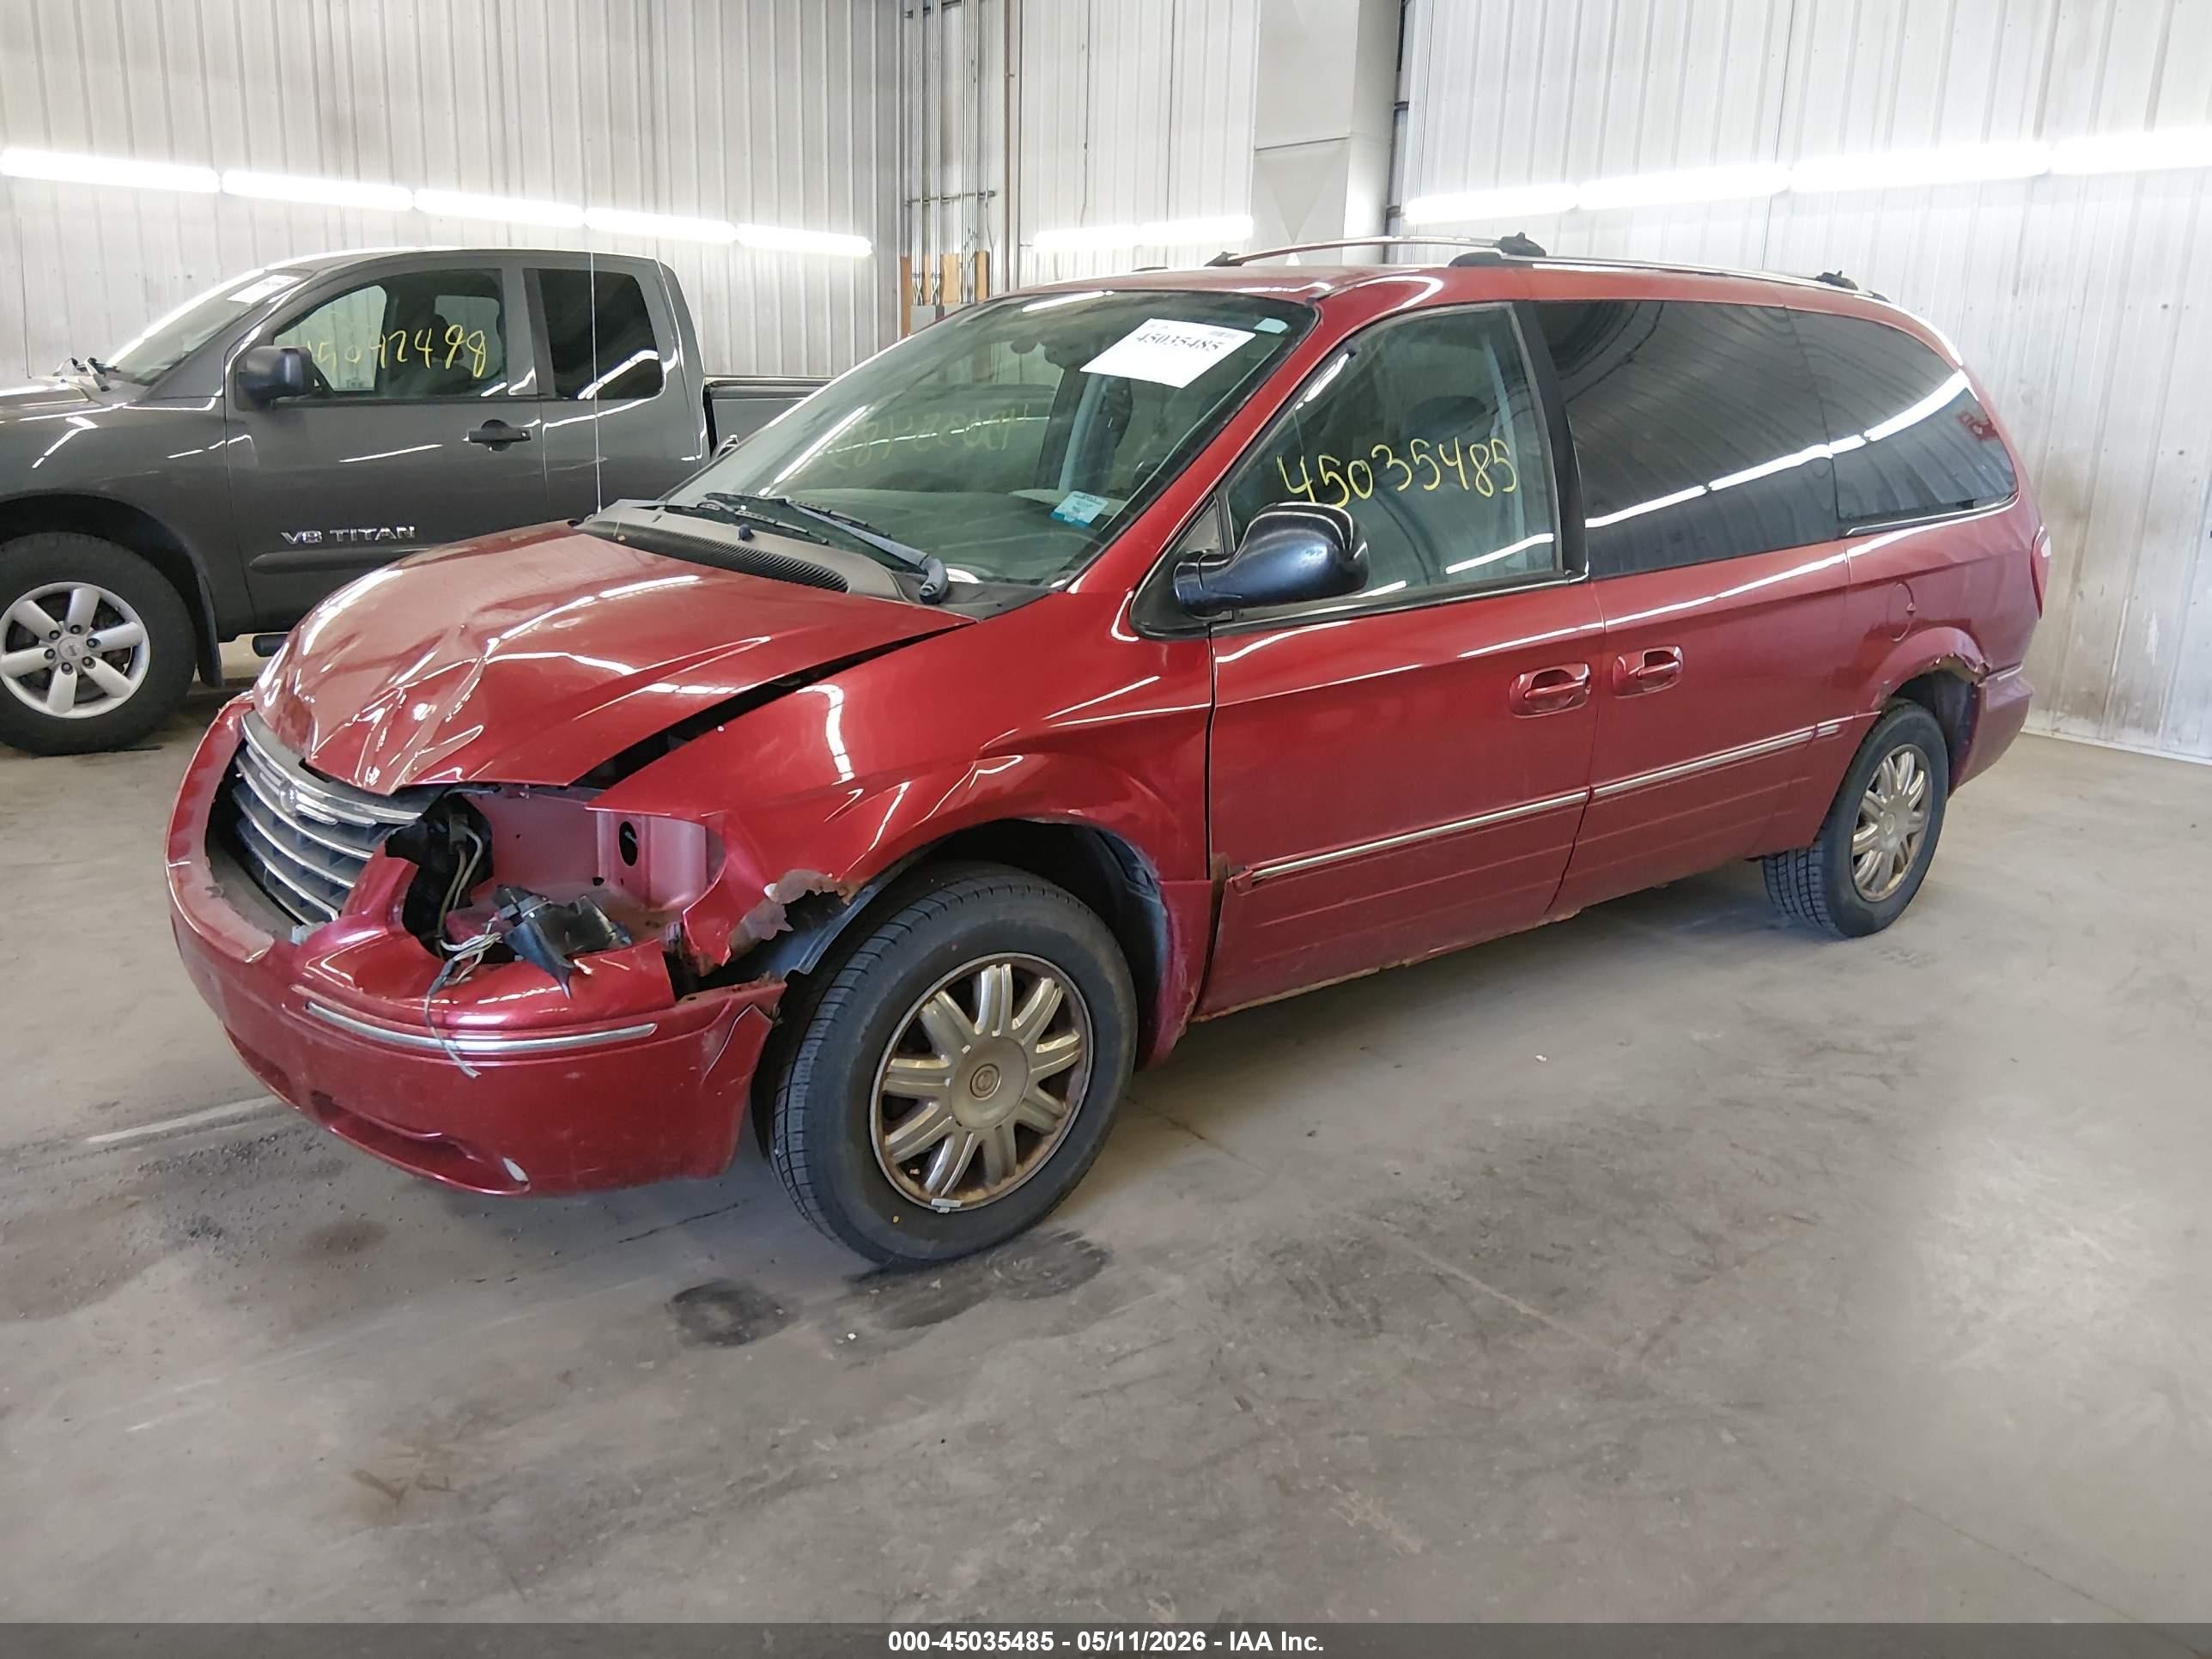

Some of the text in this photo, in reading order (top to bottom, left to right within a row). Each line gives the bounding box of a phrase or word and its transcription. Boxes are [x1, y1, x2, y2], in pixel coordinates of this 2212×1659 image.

[1136, 332, 1224, 351] 45035485
[1277, 436, 1518, 508] 45035485
[281, 526, 416, 544] V8 TITAN
